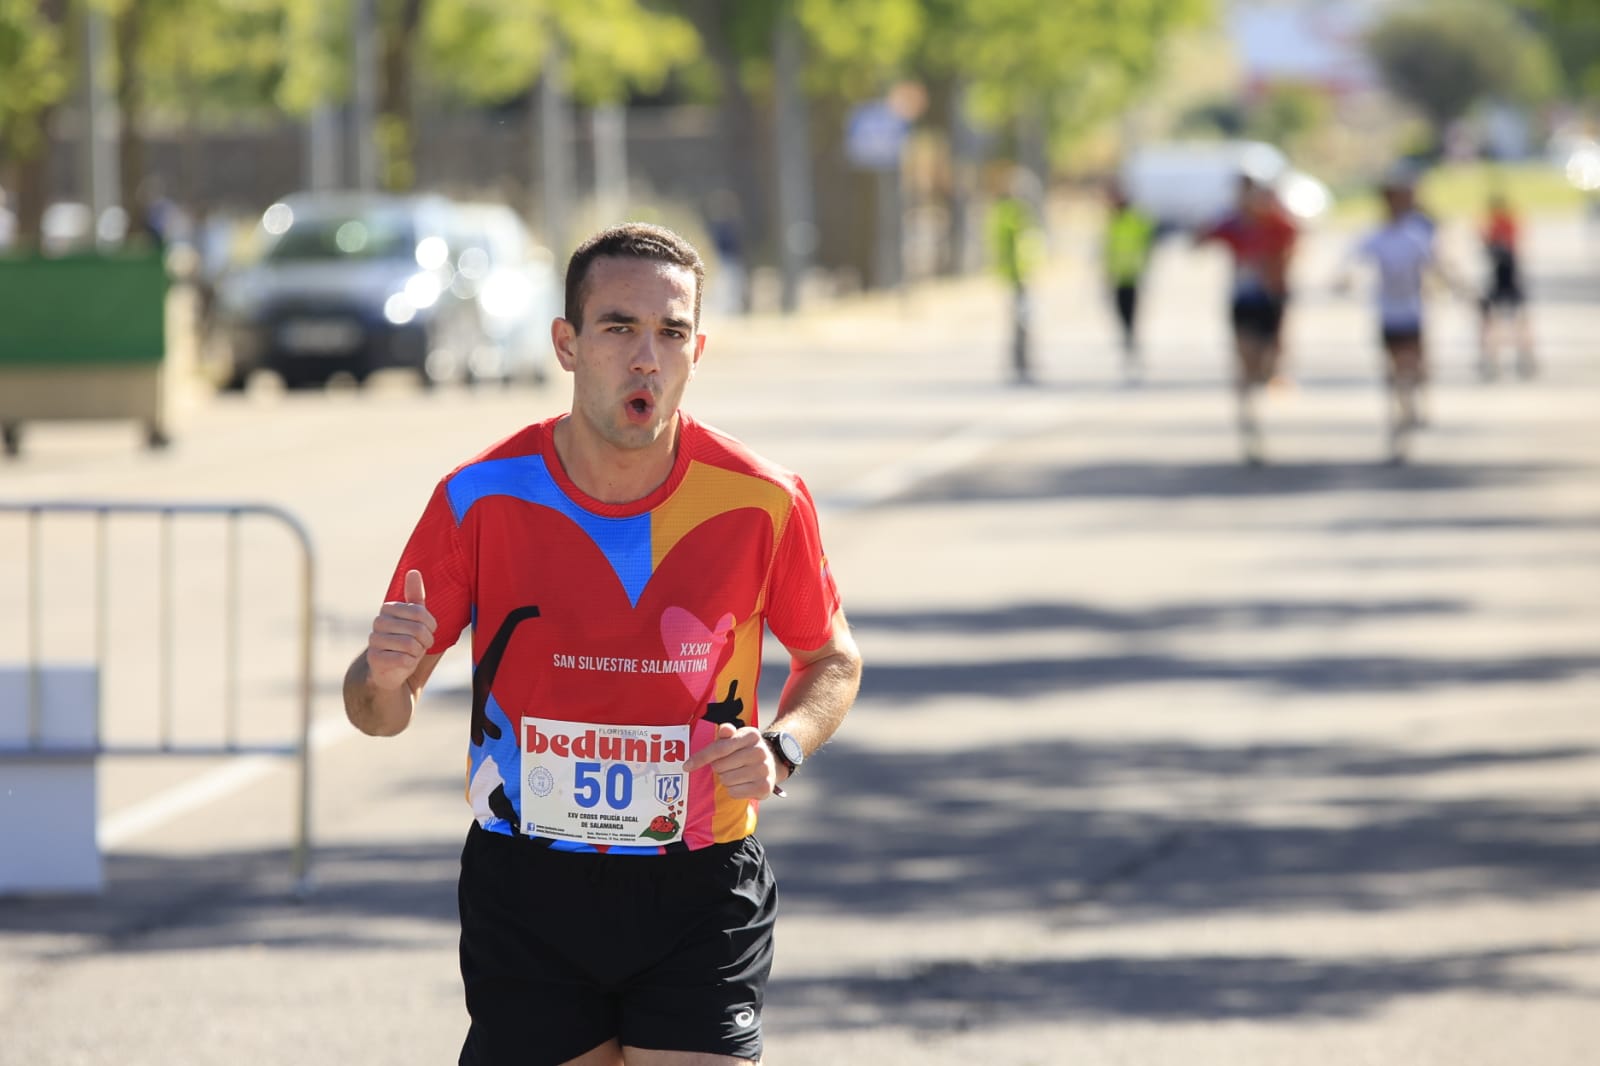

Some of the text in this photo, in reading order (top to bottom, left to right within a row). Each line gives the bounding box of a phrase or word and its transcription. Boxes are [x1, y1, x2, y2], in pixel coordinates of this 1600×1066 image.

[553, 654, 708, 674] SAN SILVESTRE SALMANTINA
[681, 643, 712, 656] XXXIX
[526, 725, 685, 763] bedunia
[574, 762, 633, 810] 50
